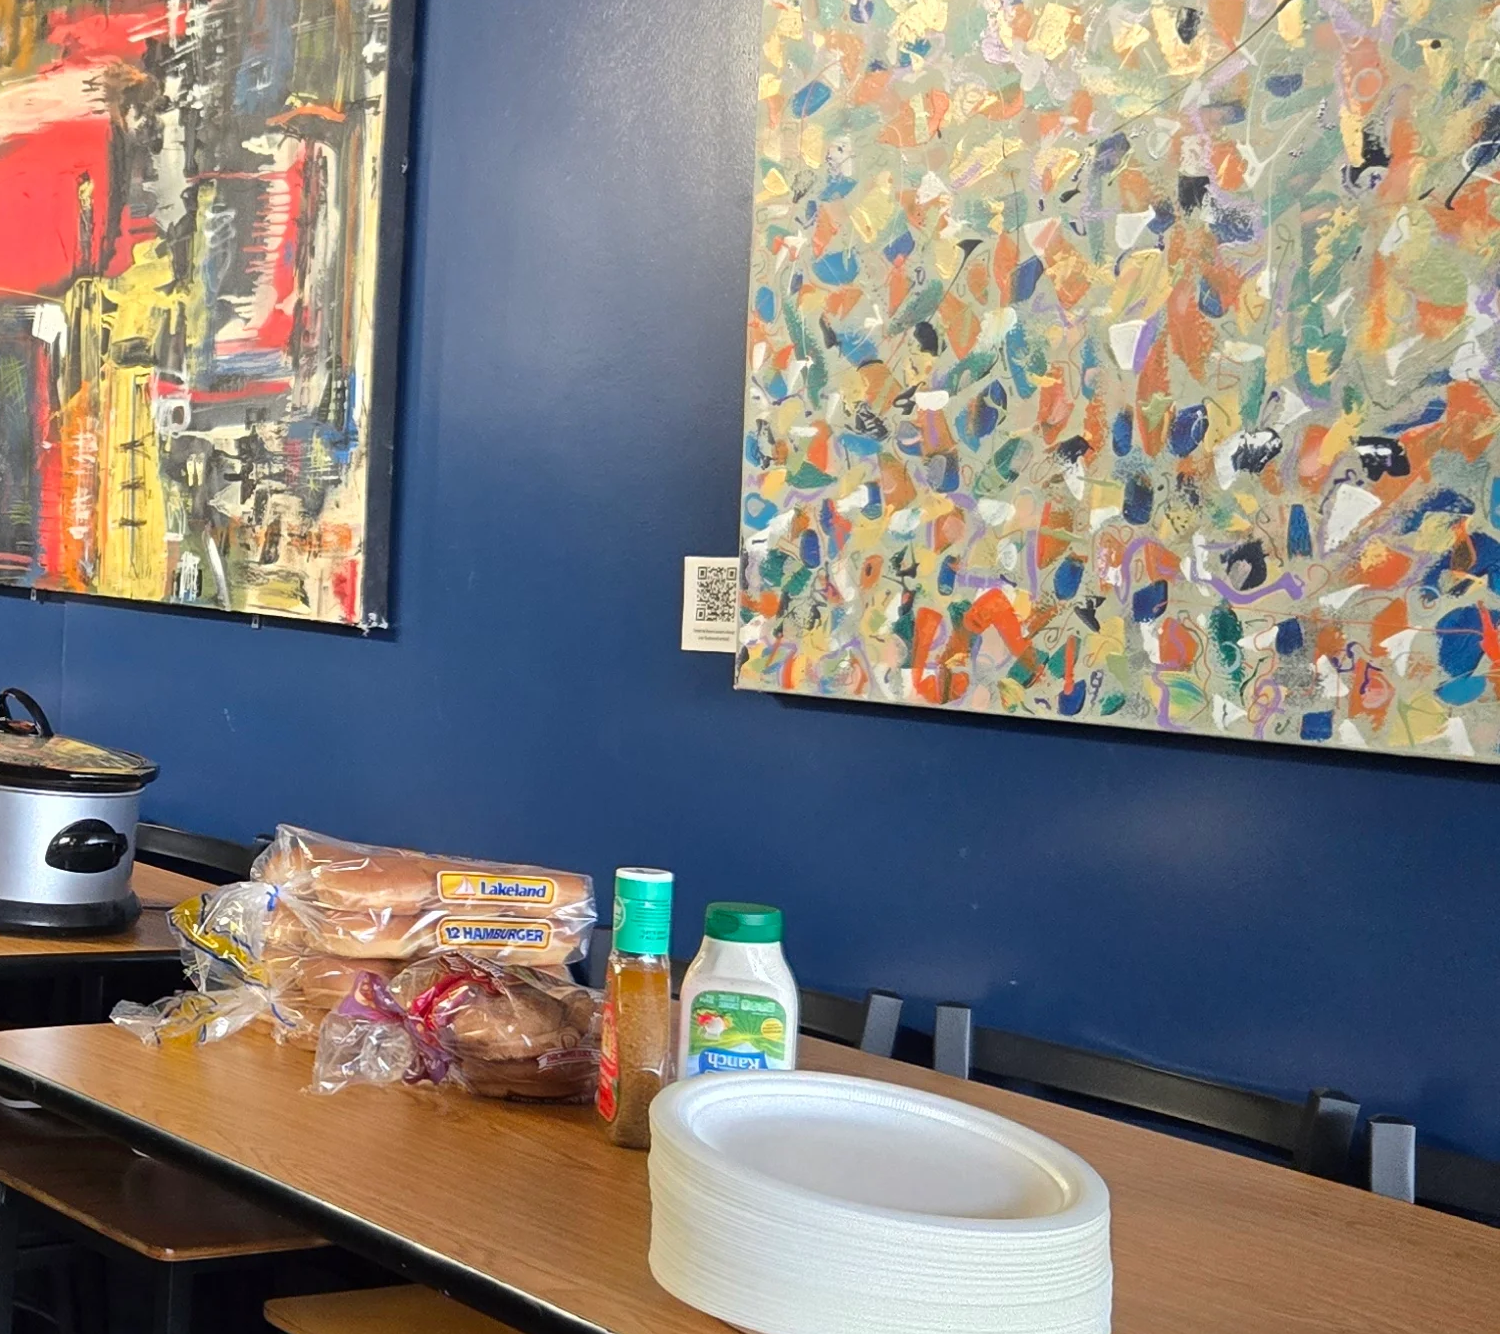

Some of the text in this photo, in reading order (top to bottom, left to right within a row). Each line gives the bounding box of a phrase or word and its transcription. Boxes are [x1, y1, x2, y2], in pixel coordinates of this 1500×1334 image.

[481, 881, 547, 898] Lakeland
[445, 927, 544, 942] 12 HAMBURGER
